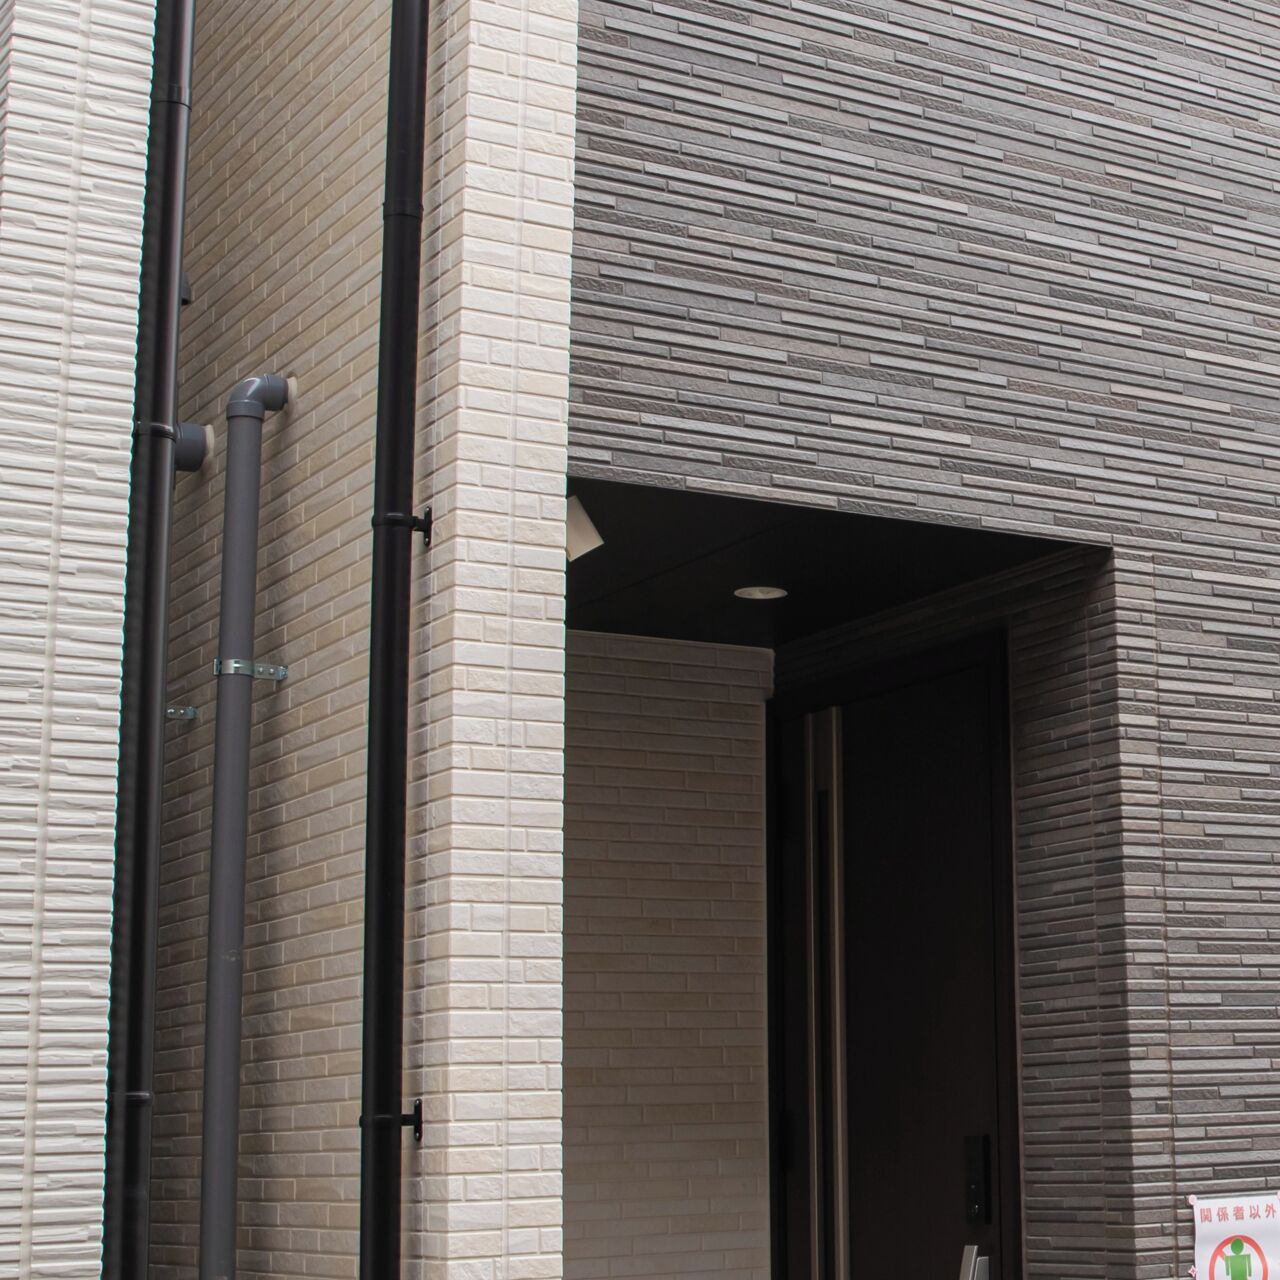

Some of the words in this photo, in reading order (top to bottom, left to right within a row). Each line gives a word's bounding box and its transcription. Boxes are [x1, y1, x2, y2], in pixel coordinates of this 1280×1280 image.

[1200, 1203, 1277, 1223] 関係者以外
